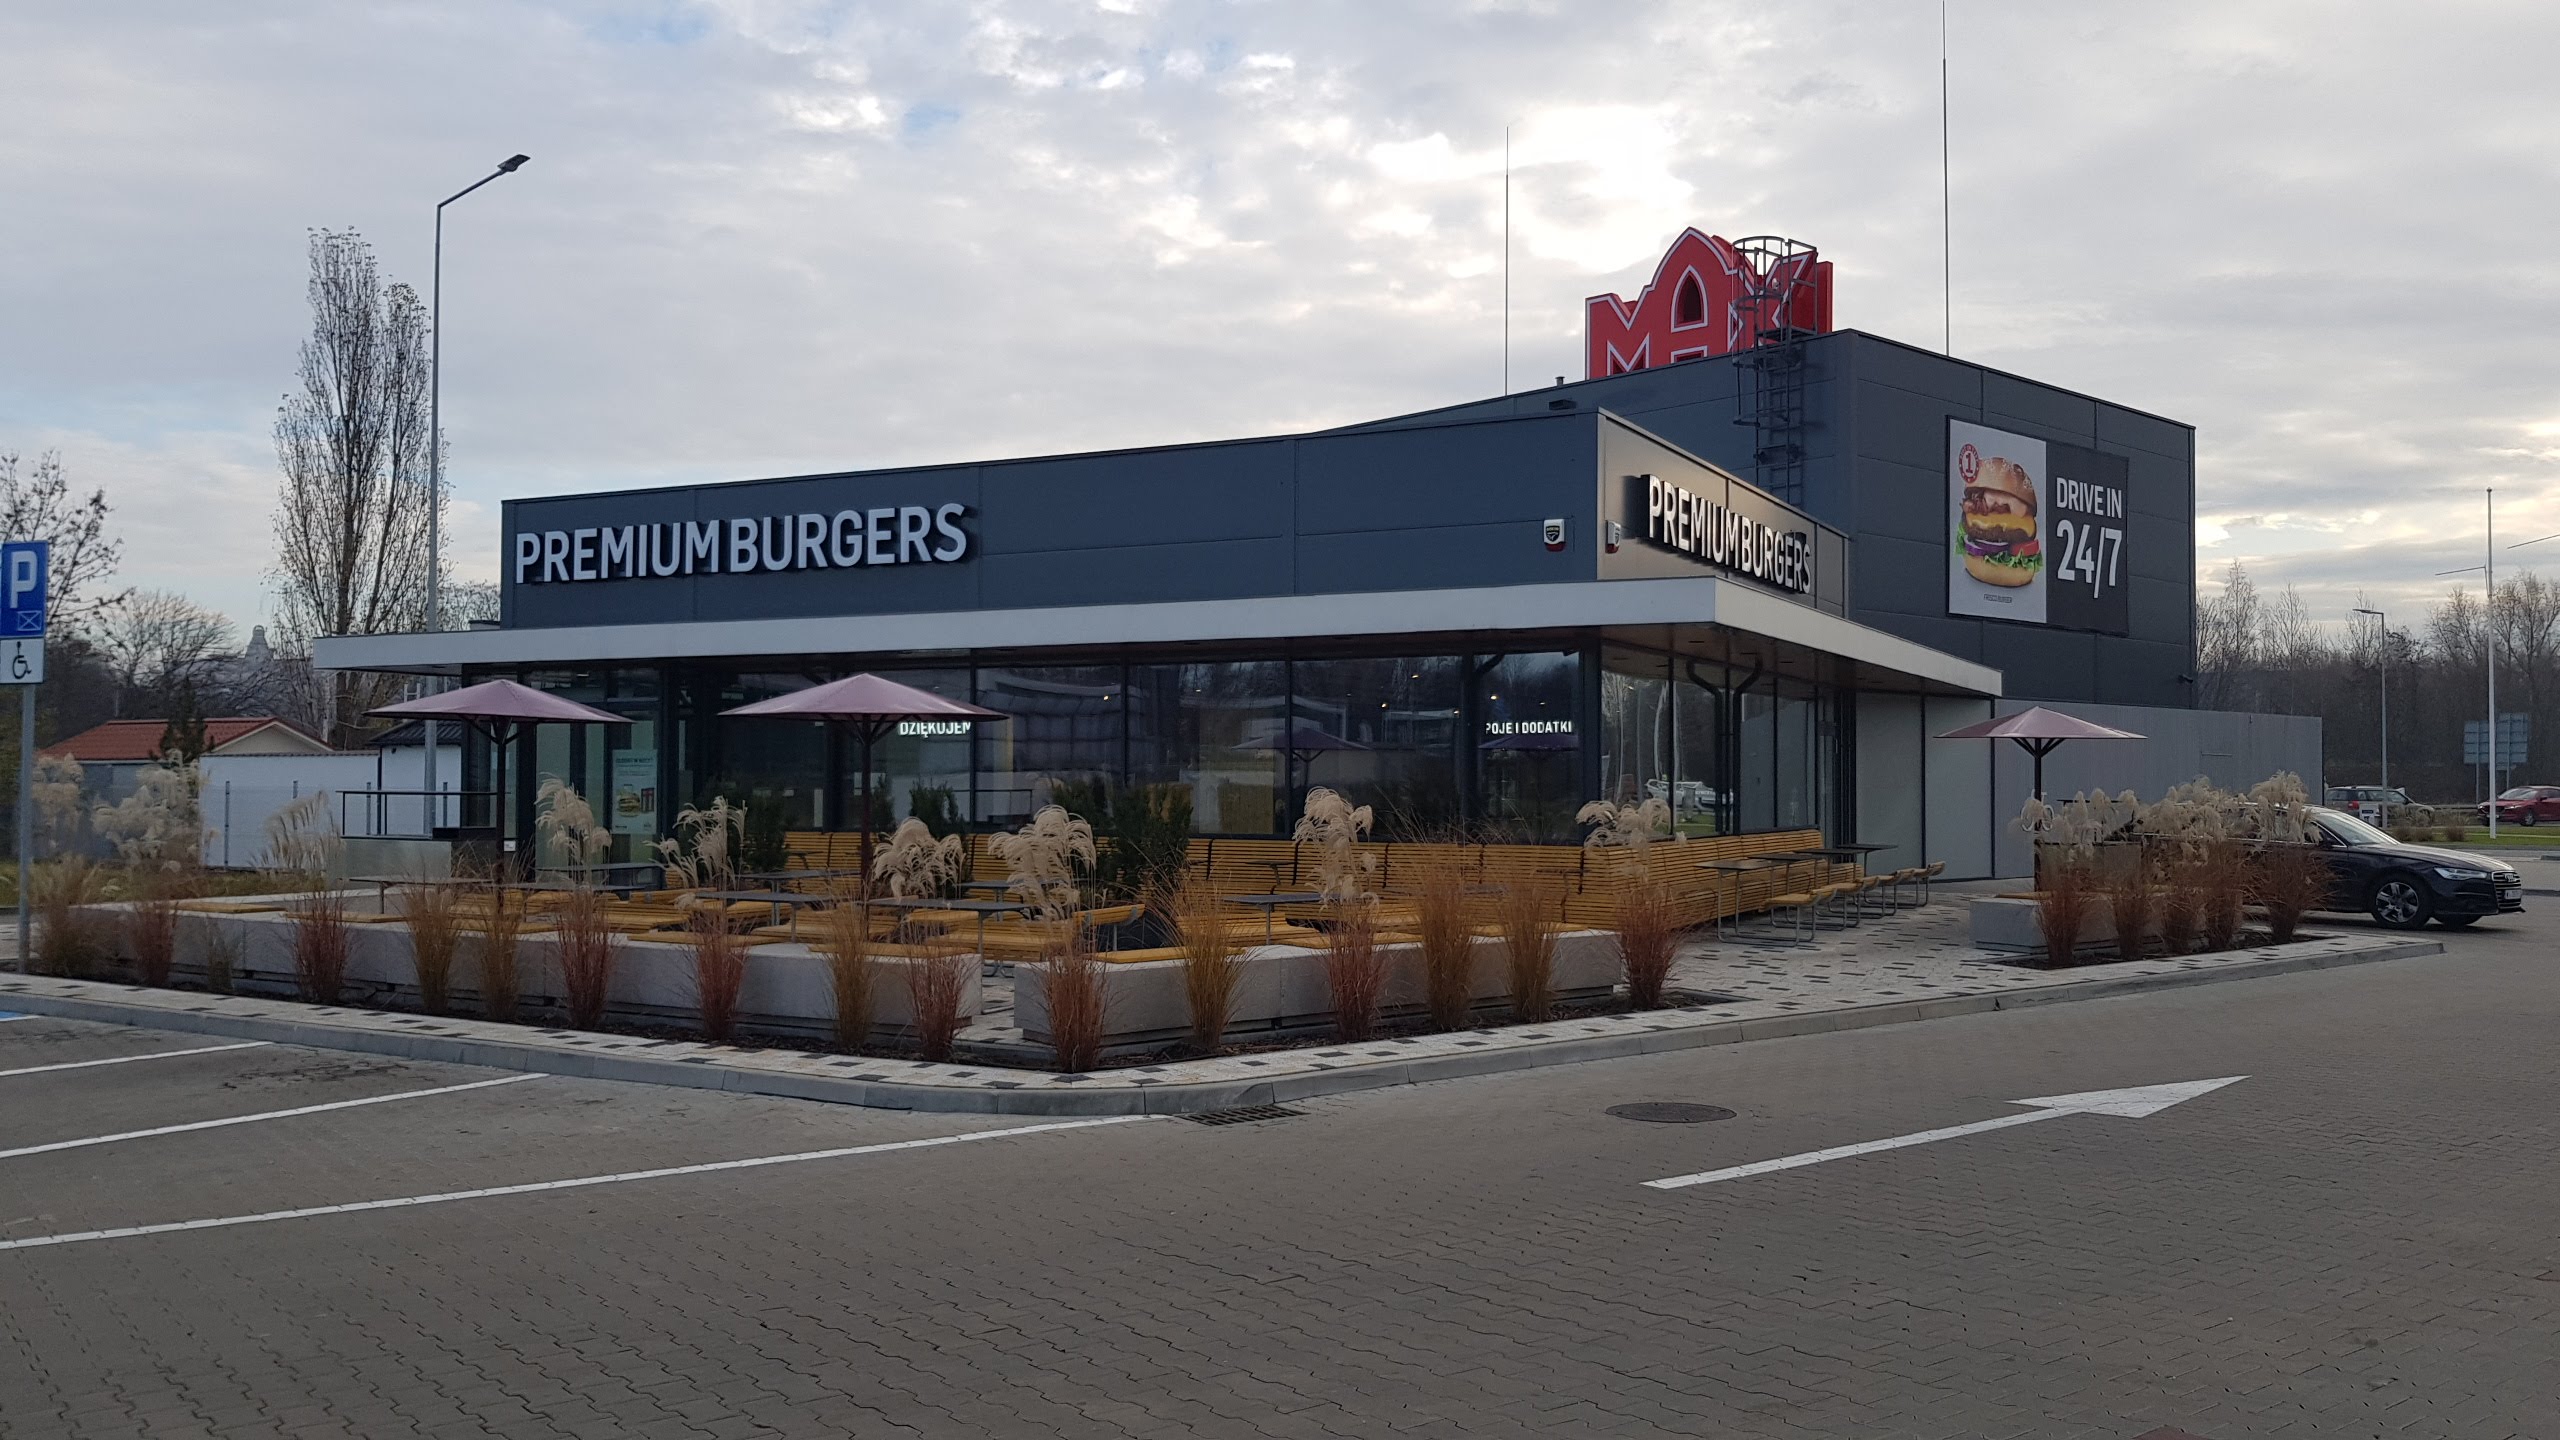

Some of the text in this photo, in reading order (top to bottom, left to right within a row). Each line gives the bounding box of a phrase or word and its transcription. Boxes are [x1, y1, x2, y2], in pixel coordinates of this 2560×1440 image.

[1585, 226, 1833, 380] MAX
[1965, 452, 1973, 474] 1
[2056, 477, 2122, 519] DRIVE IN
[515, 502, 967, 584] PREMIUM BURGERS
[1648, 474, 1811, 595] PREMIUM BURGERS
[2056, 519, 2122, 598] 24/7
[9, 550, 38, 609] P
[1515, 721, 1519, 734] I
[1521, 720, 1572, 734] DODATKI
